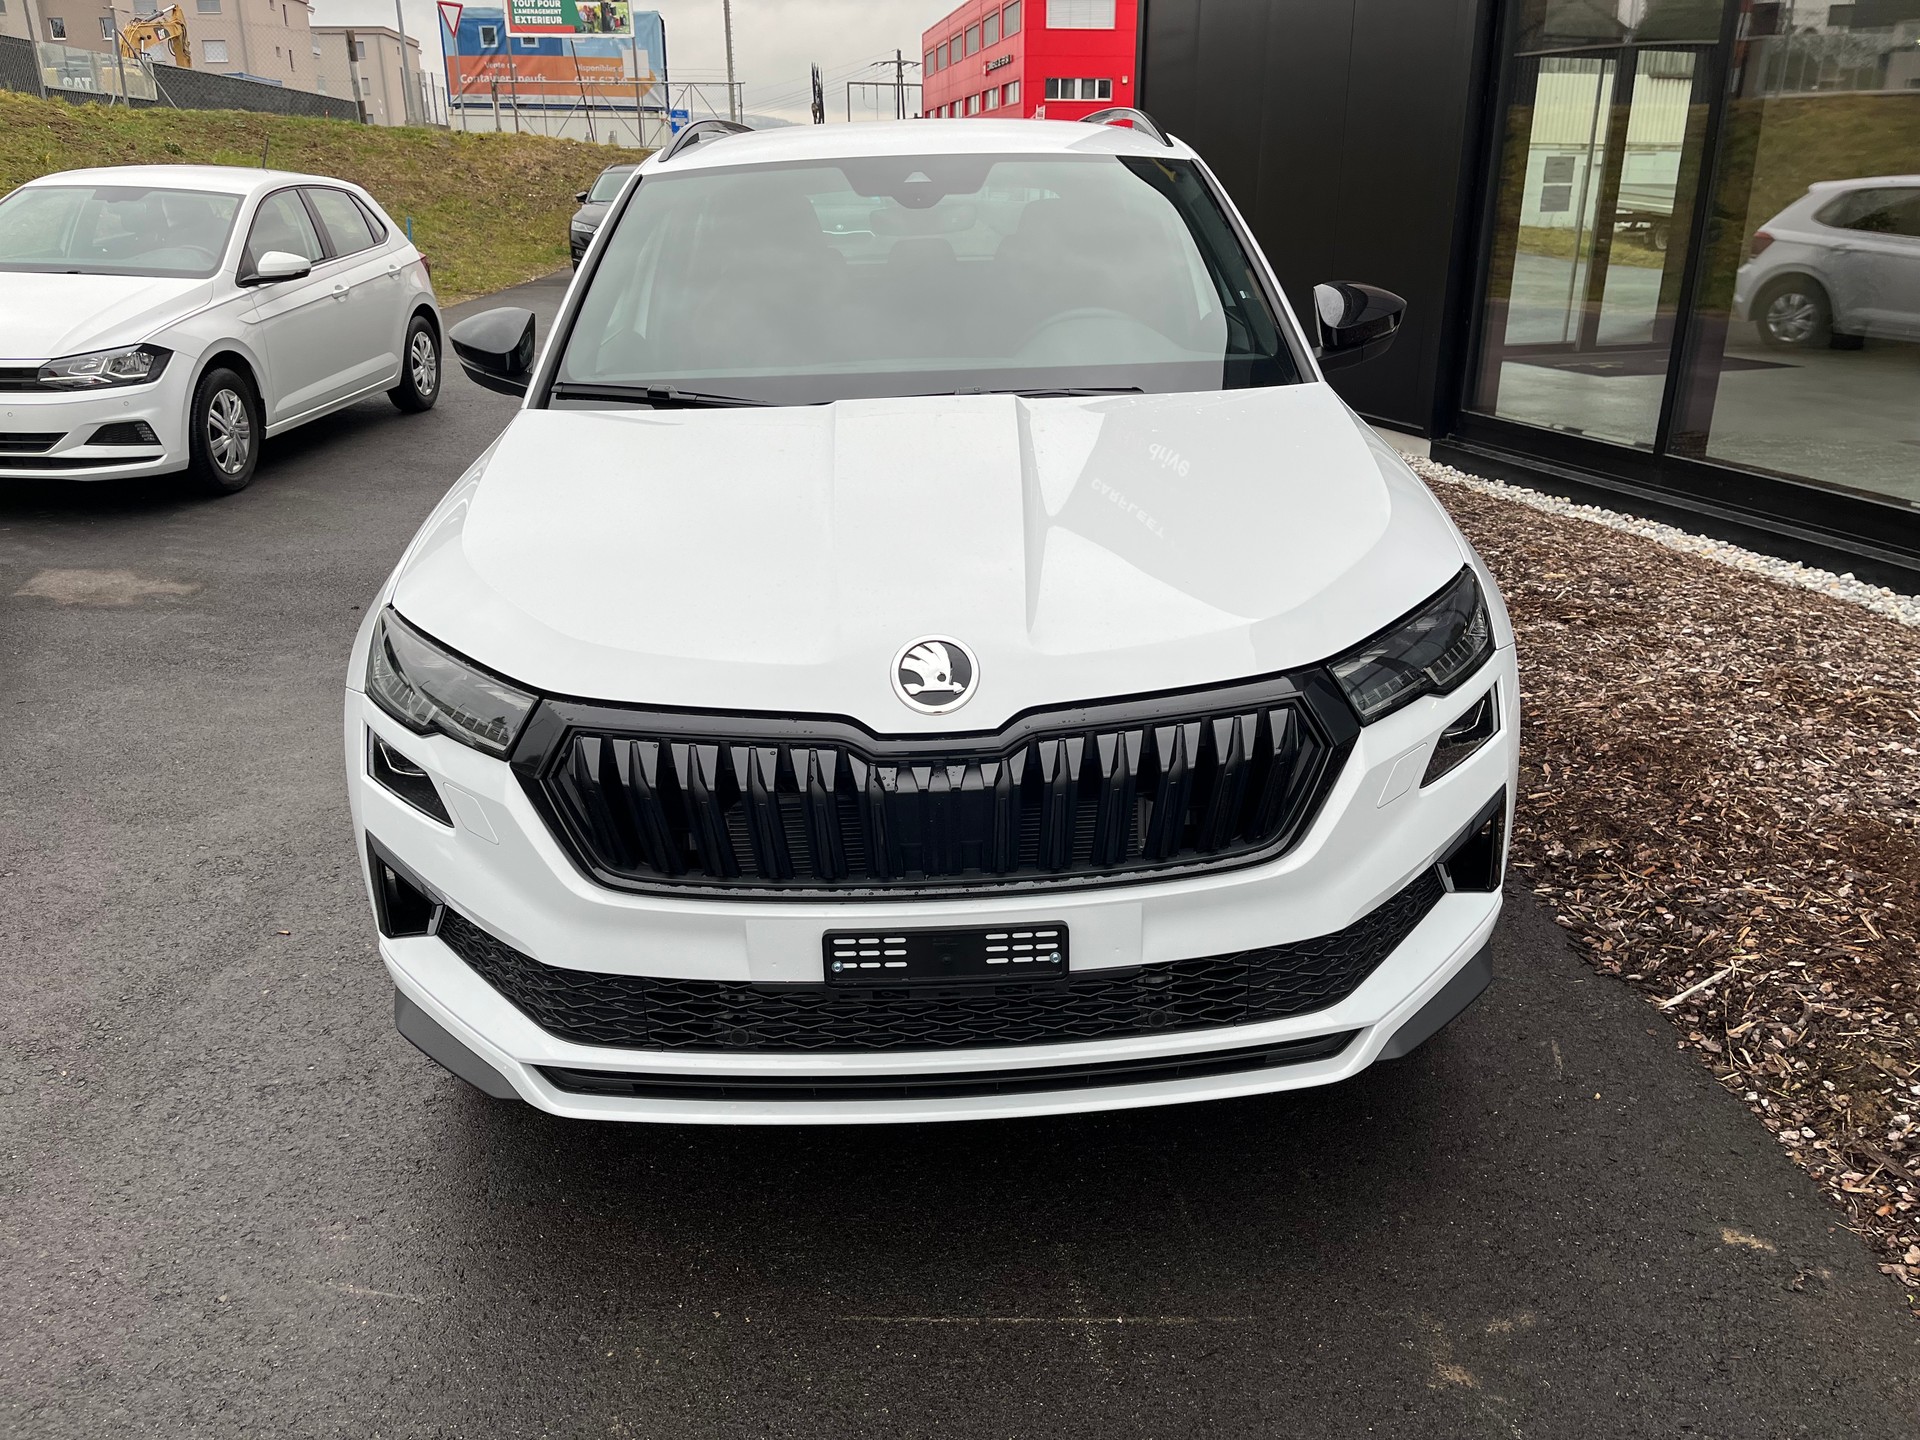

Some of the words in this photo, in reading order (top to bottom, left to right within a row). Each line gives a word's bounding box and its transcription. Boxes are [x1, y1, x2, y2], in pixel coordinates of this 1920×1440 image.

[514, 15, 563, 24] EXTERIEUR
[62, 76, 92, 90] CAT
[460, 73, 517, 84] Container
